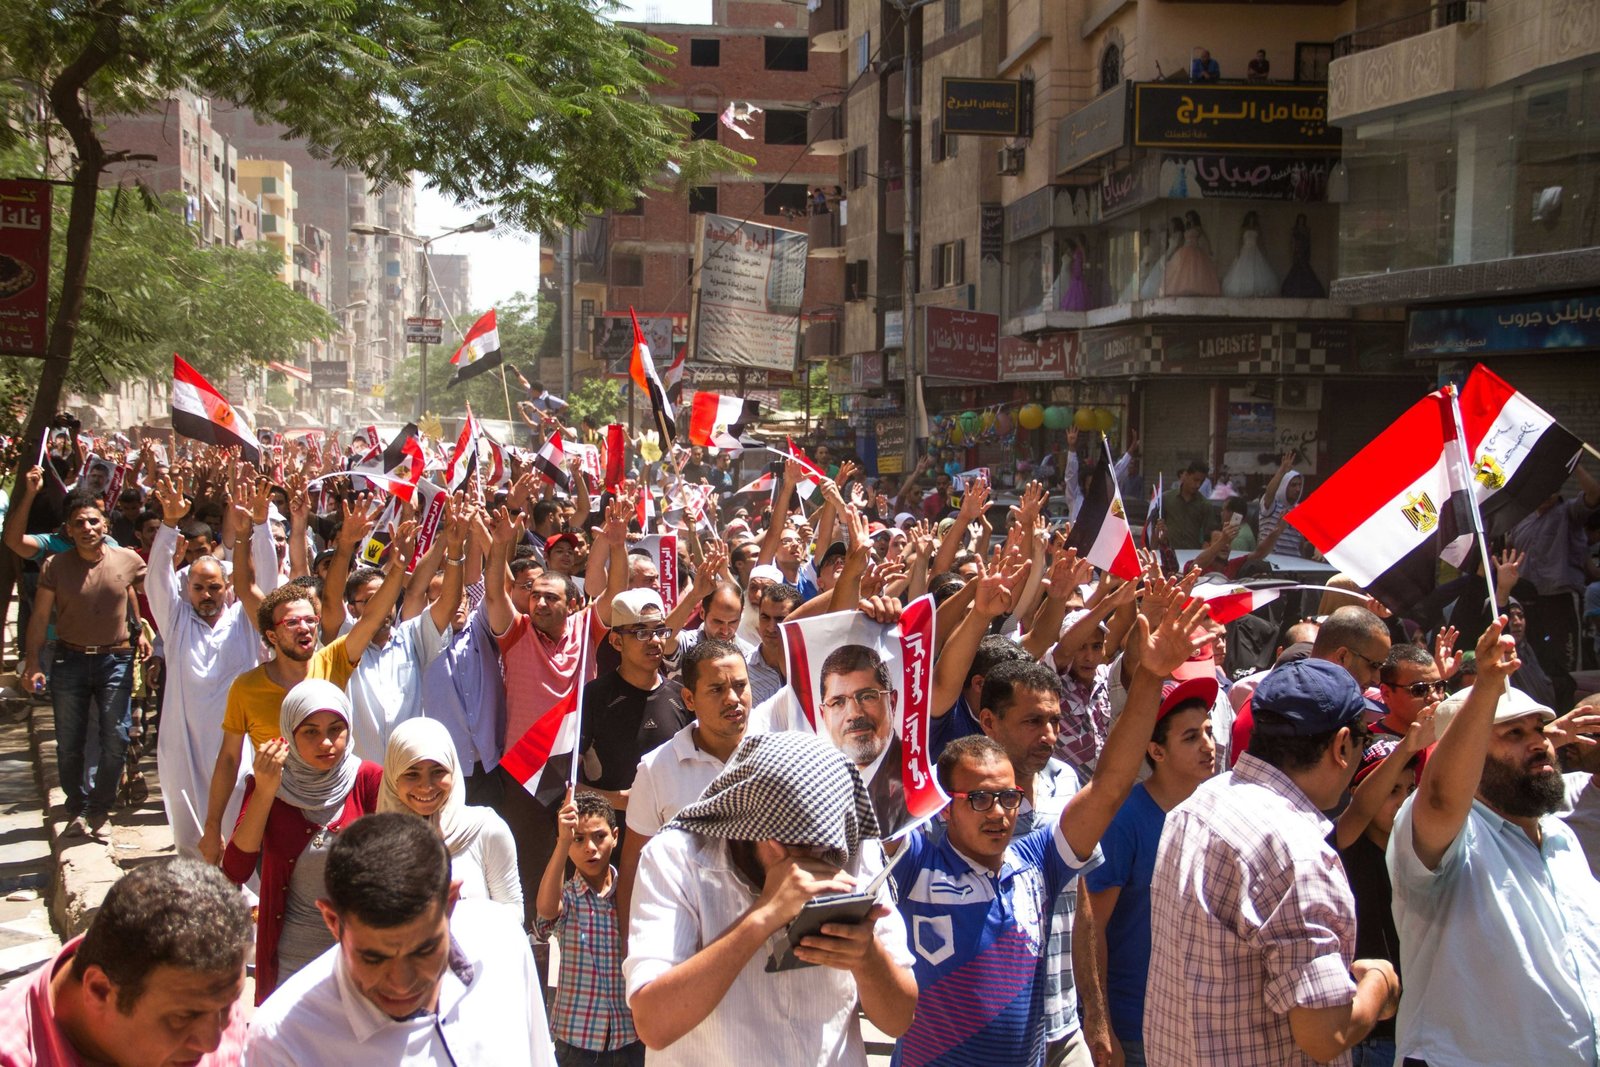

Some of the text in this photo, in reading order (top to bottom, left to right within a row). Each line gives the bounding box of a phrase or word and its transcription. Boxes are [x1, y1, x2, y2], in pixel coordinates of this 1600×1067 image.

[1176, 96, 1256, 124] البرج
[1197, 156, 1270, 187] صبايا
[950, 312, 978, 325] مركز
[1498, 311, 1543, 328] جروب
[966, 332, 997, 358] تبارك
[1199, 333, 1256, 359] LACOSTE
[426, 500, 440, 535] الرئيس
[661, 547, 673, 580] الرئيس
[904, 632, 926, 705] الرئيس
